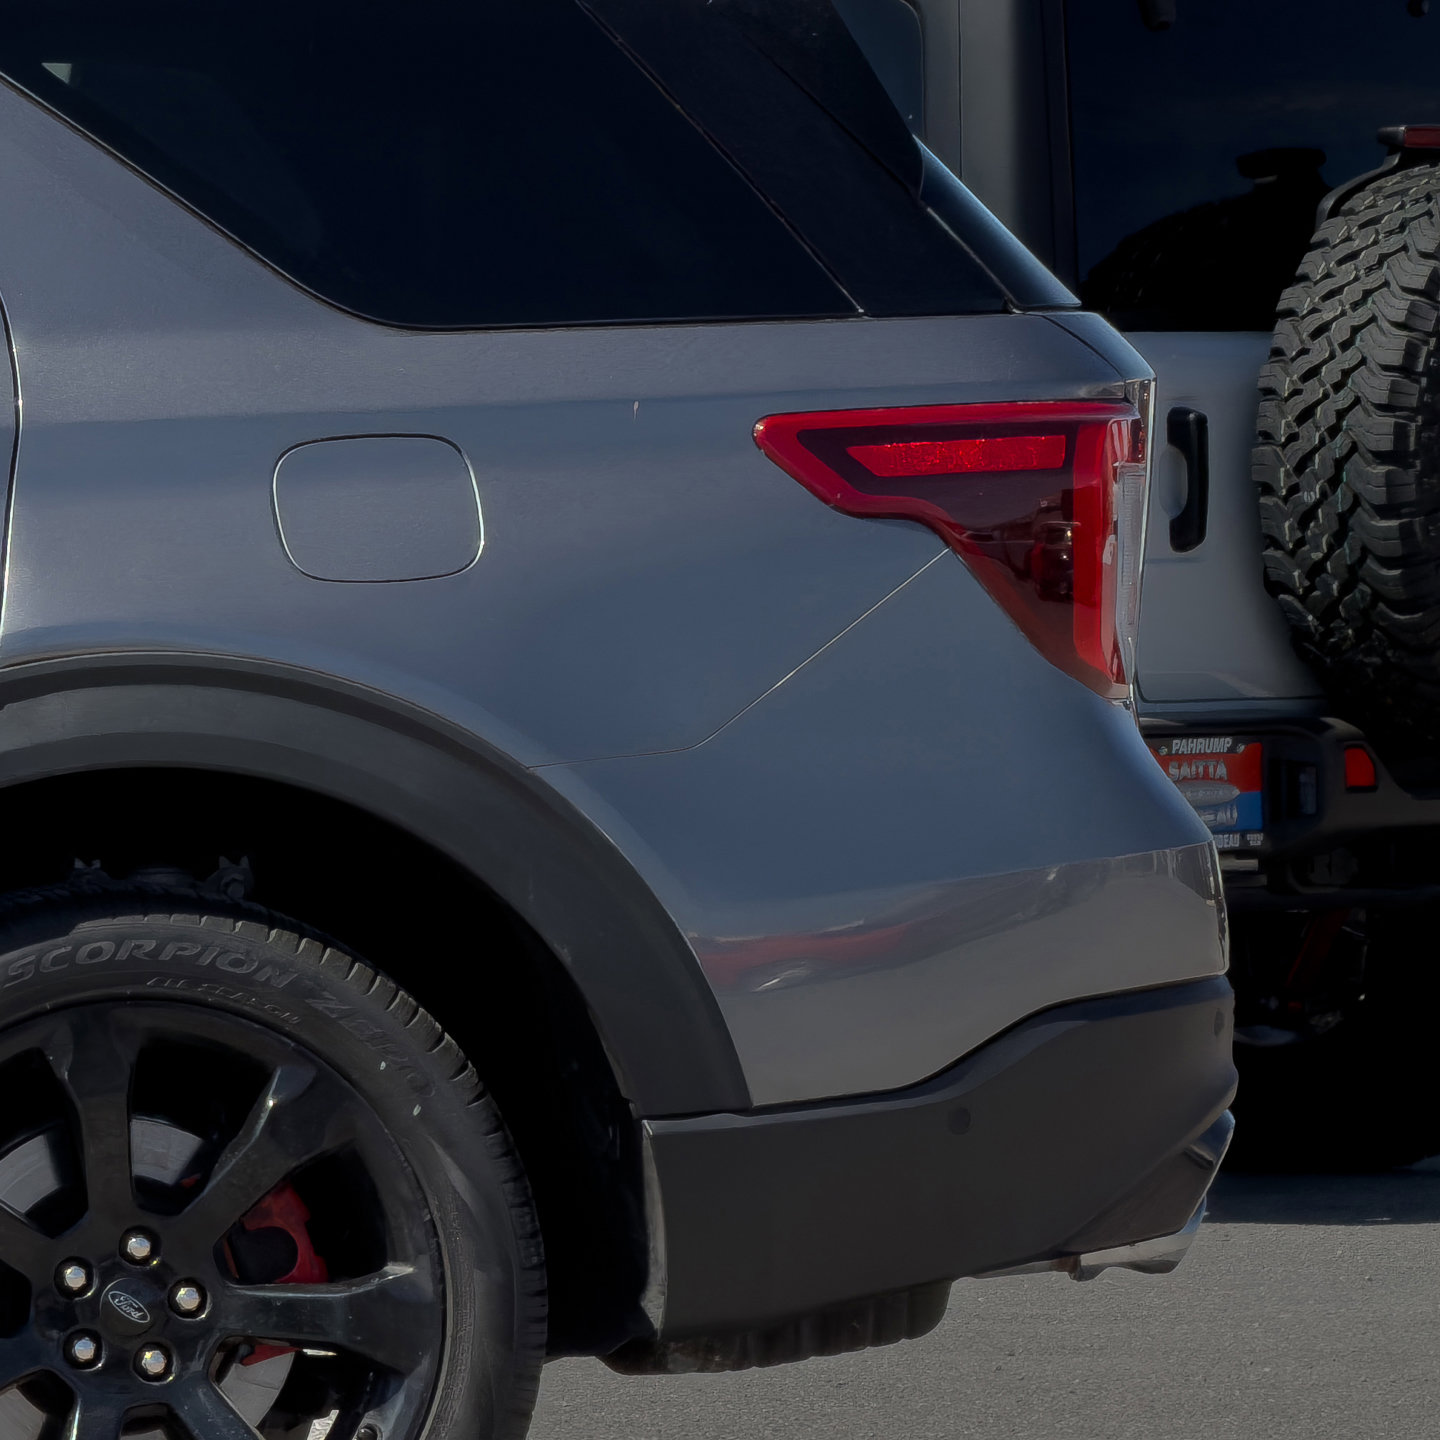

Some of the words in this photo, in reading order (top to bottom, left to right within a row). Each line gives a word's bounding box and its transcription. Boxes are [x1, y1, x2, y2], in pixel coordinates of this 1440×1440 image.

[1171, 738, 1233, 755] PAHRUMP
[1168, 759, 1228, 781] SAITTA
[2, 937, 303, 991] SCORPION
[113, 1294, 146, 1320] Ford
